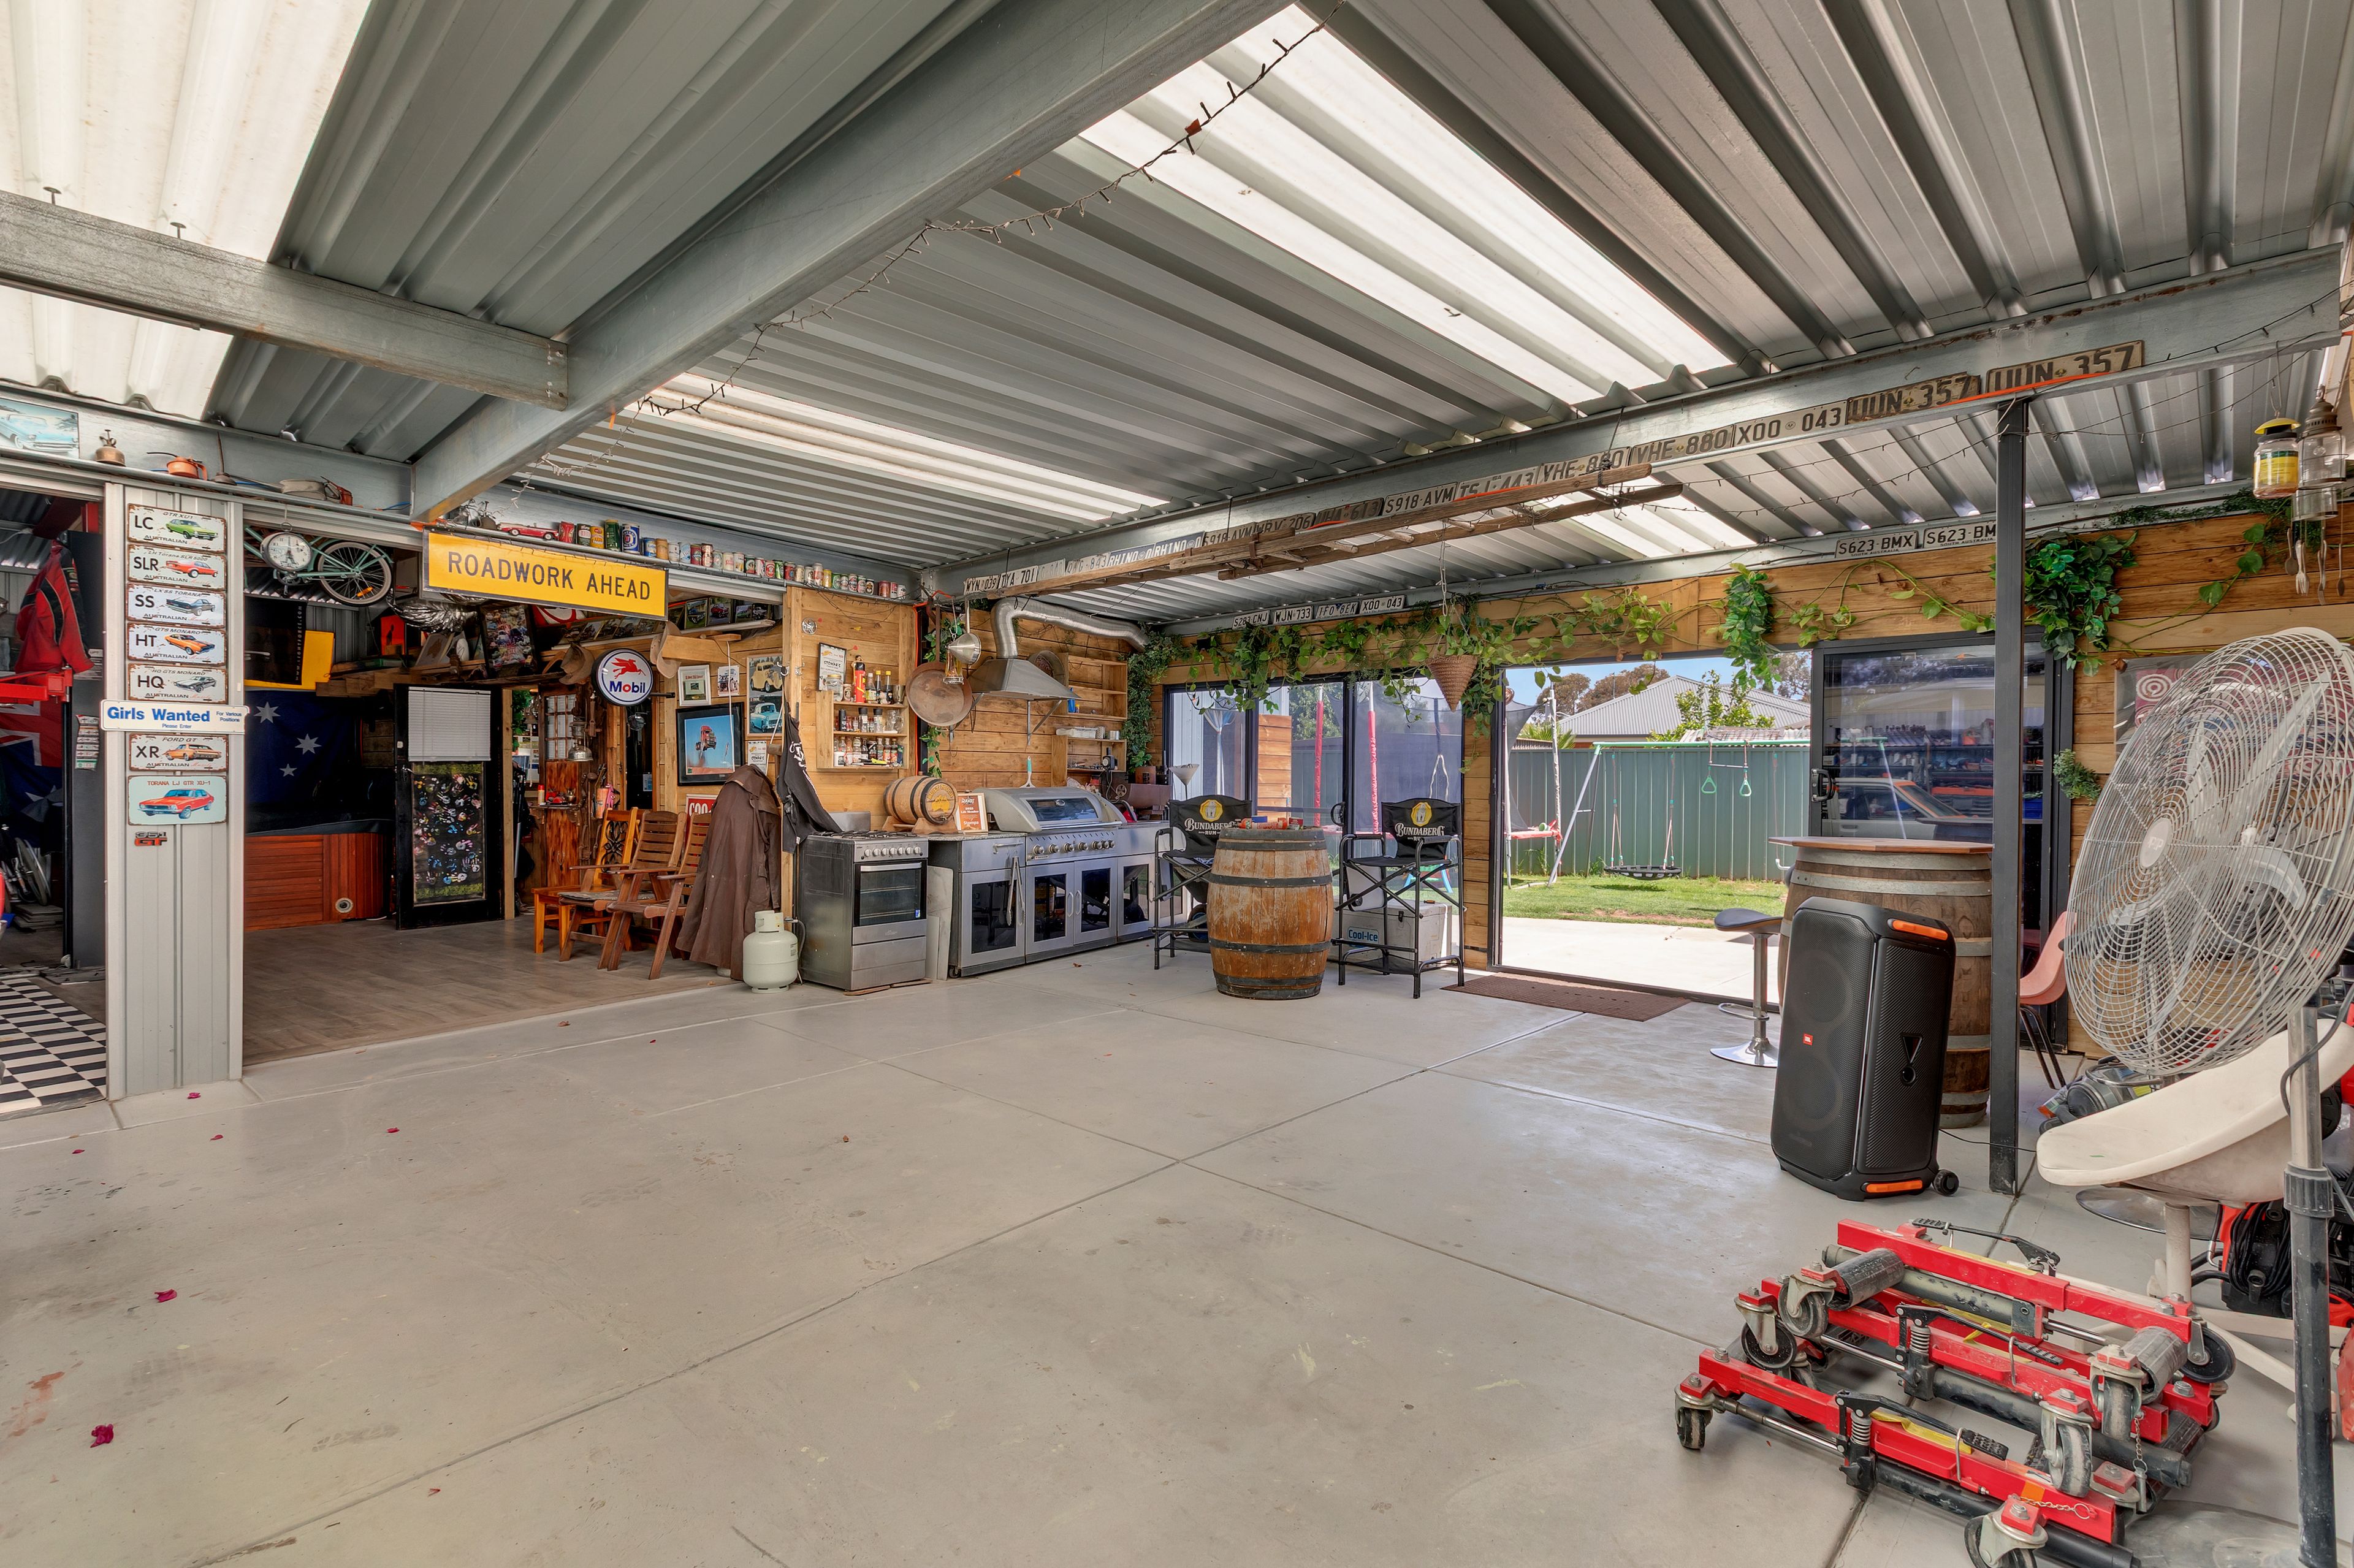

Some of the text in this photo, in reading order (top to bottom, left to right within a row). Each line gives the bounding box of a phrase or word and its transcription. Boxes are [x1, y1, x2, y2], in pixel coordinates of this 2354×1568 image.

[2073, 344, 2135, 375] 357
[1802, 407, 1842, 432] 043
[1637, 429, 1728, 464] VHE 880
[1544, 460, 1579, 482] VHE
[135, 515, 154, 530] LC
[1926, 524, 1996, 544] S623-BM
[1154, 540, 1186, 557] RHINO
[1838, 534, 1914, 555] S623-BMX
[134, 556, 159, 571] SLR
[1108, 550, 1138, 566] RHINO
[448, 551, 650, 601] ROADWORK AHEAD
[984, 577, 997, 590] 039
[135, 594, 154, 608] SS
[1387, 597, 1402, 608] 043
[1275, 609, 1293, 622] WJN
[1296, 608, 1311, 620] 733
[136, 634, 157, 647] HT
[137, 675, 165, 689] HQ
[609, 680, 646, 693] Mobil
[107, 706, 210, 722] Girls Wanted
[135, 745, 160, 759] XR
[1395, 822, 1445, 837] BUNDABERG
[134, 837, 167, 847] GT
[1348, 929, 1378, 942] Cool-Ice
